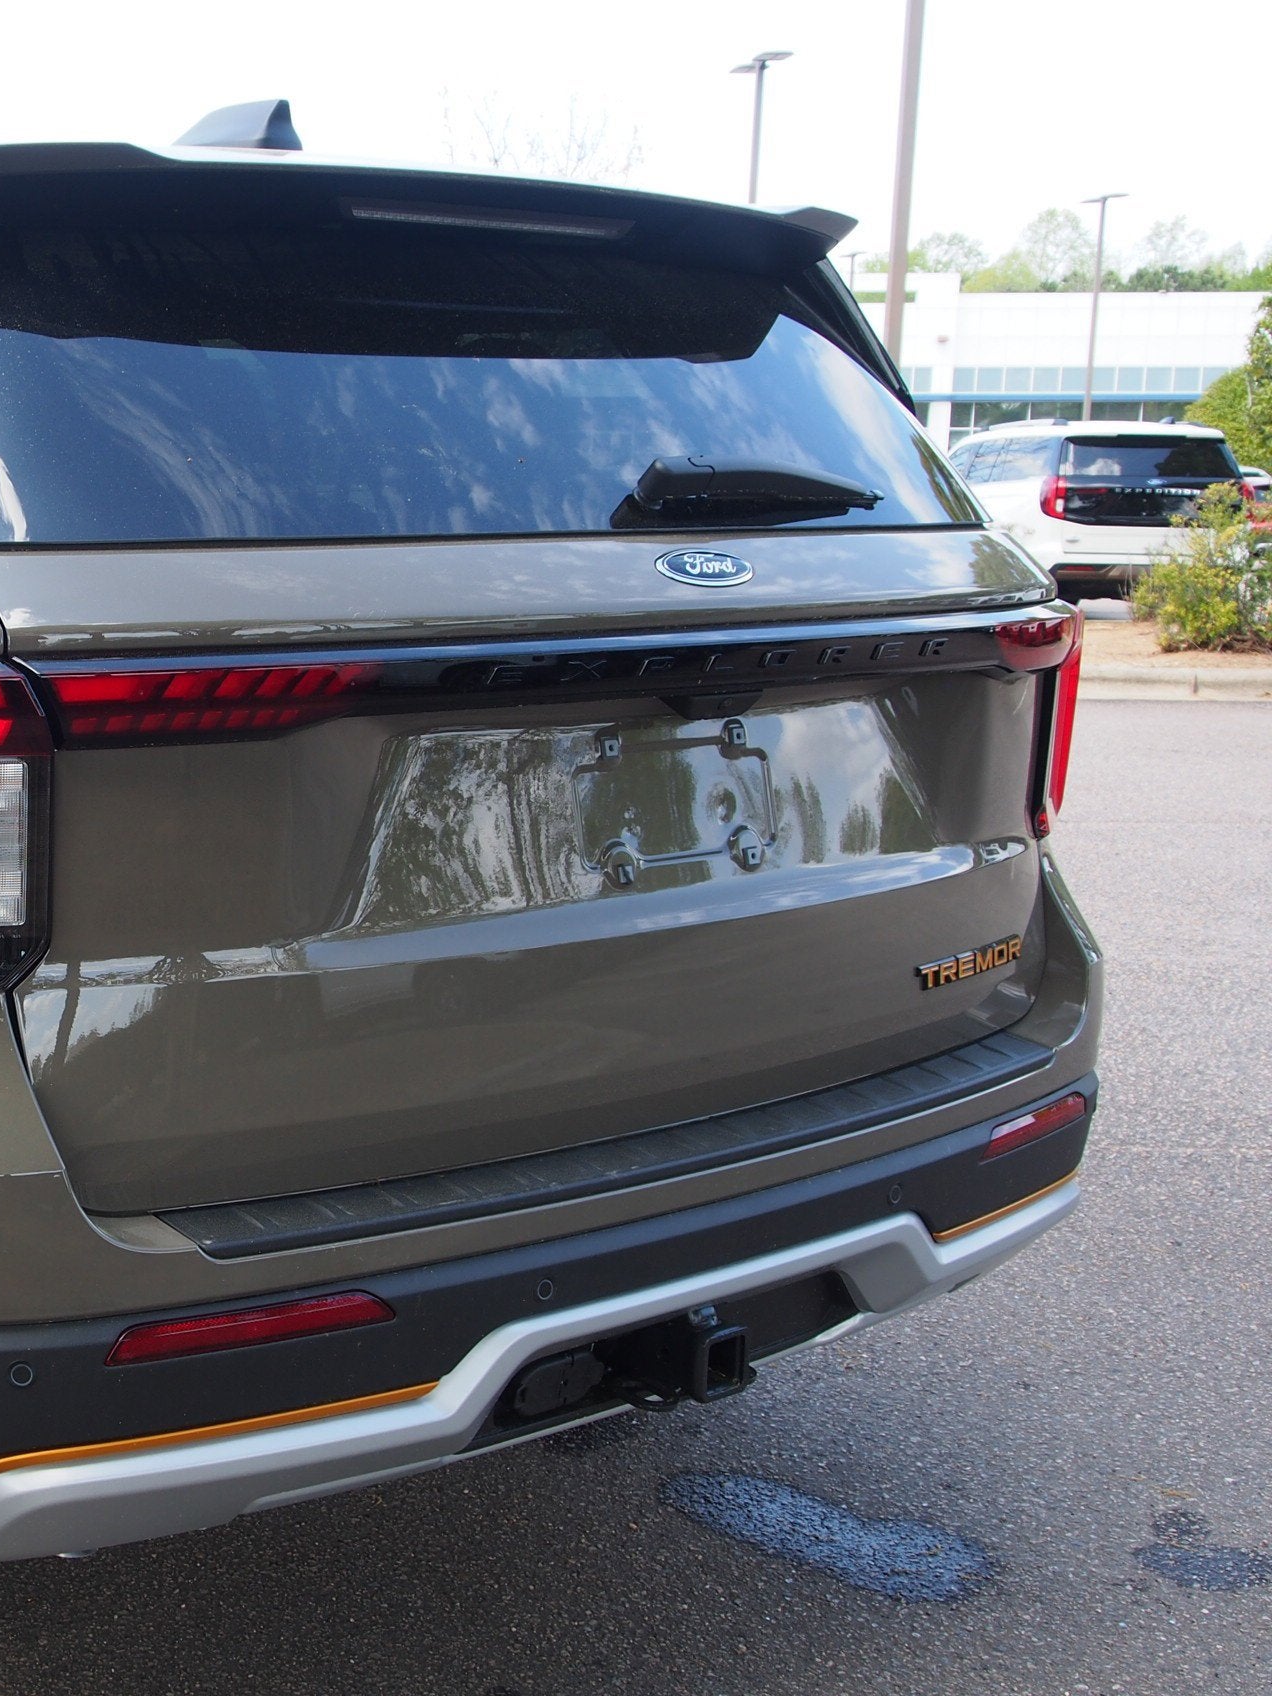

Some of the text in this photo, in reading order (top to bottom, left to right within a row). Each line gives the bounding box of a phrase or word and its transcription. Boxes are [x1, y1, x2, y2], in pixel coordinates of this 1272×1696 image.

[684, 553, 736, 575] Ford
[484, 637, 950, 687] EXPLORER
[918, 935, 1021, 990] TREMOR
